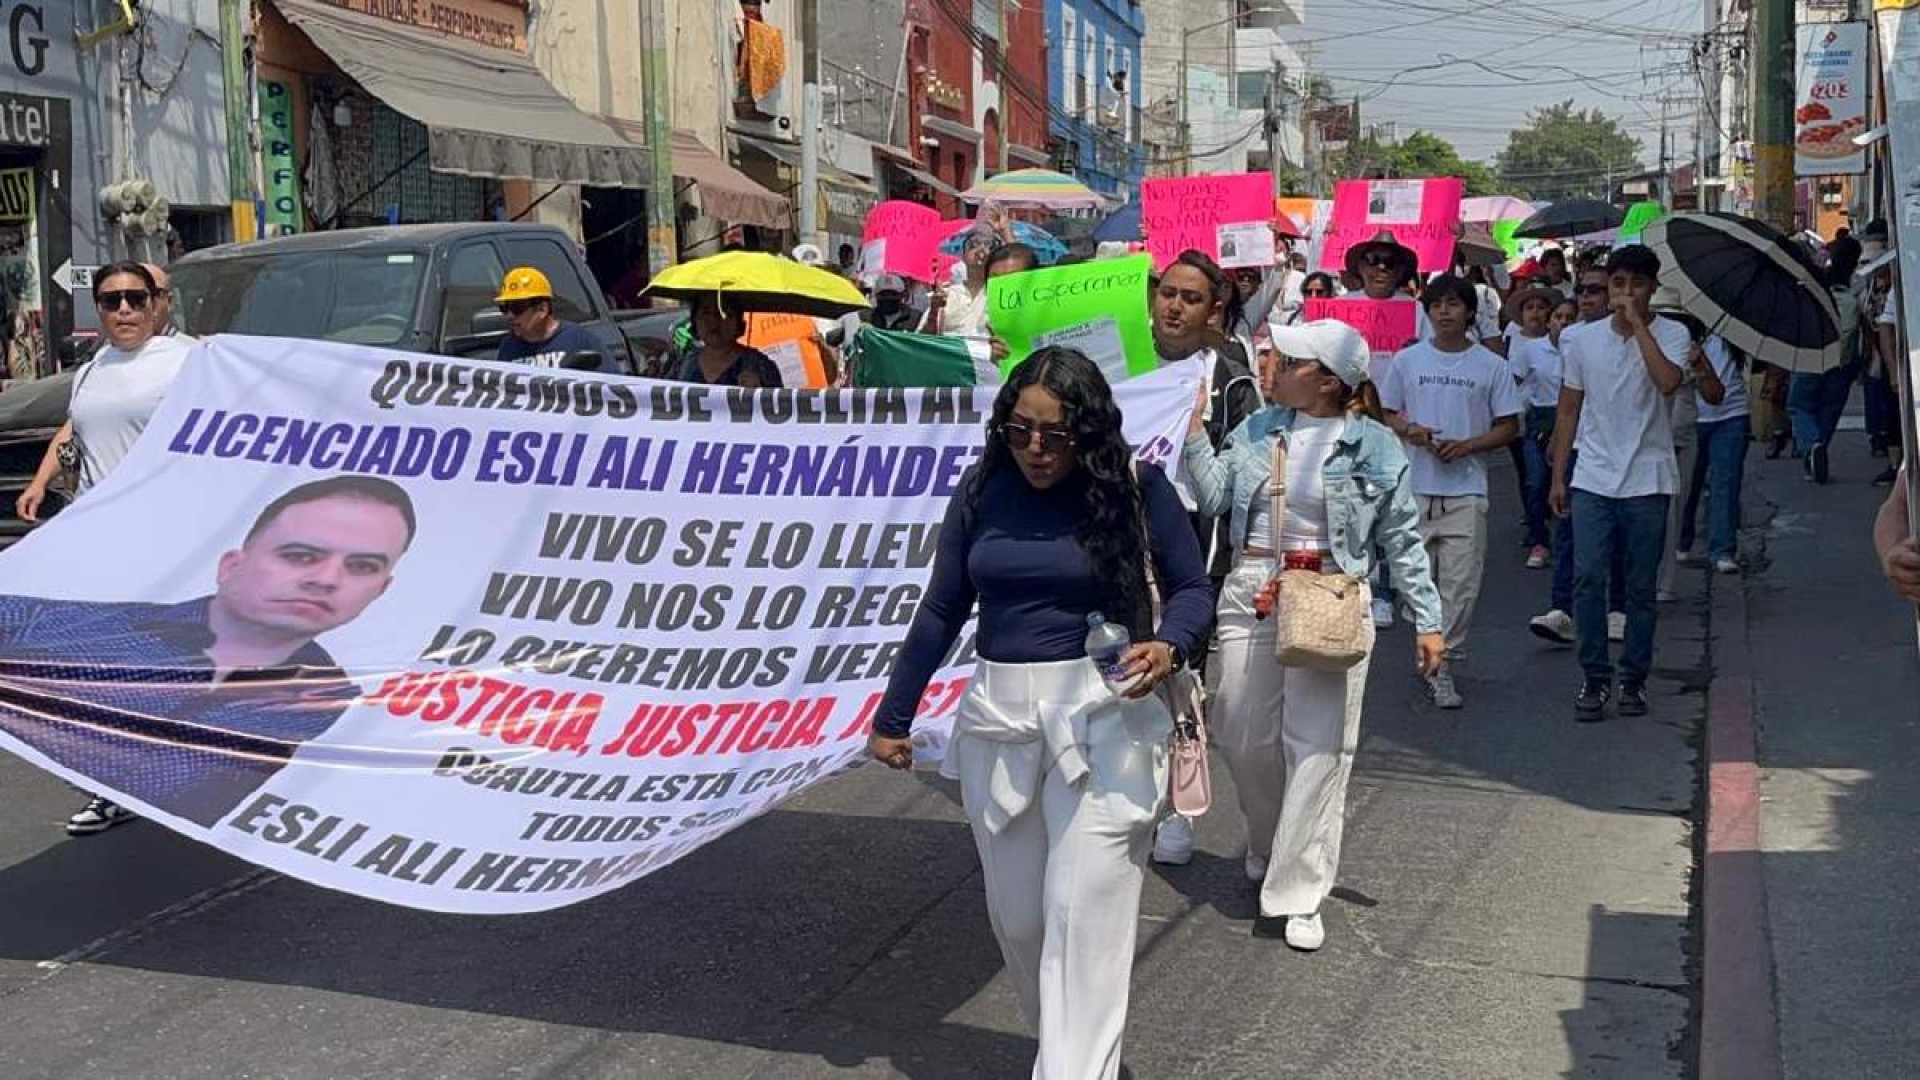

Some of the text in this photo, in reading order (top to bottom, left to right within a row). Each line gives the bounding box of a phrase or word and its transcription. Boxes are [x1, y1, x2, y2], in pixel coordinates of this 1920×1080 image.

[370, 359, 982, 424] QUEREMOS DE VUELTA AL
[168, 409, 472, 481] LICENCIADO
[474, 431, 589, 487] ESLI
[587, 435, 679, 492] ALI
[538, 512, 668, 565] VIVO
[673, 519, 744, 567] SE
[744, 521, 814, 570] LO
[480, 572, 613, 626] VIVO
[616, 583, 734, 631] NOS
[736, 585, 807, 630] LO
[420, 625, 496, 666] LO
[500, 634, 798, 690] QUEREMOS
[228, 792, 371, 862] ESLI
[352, 834, 467, 886] ALI
[520, 812, 674, 843] TODOS
